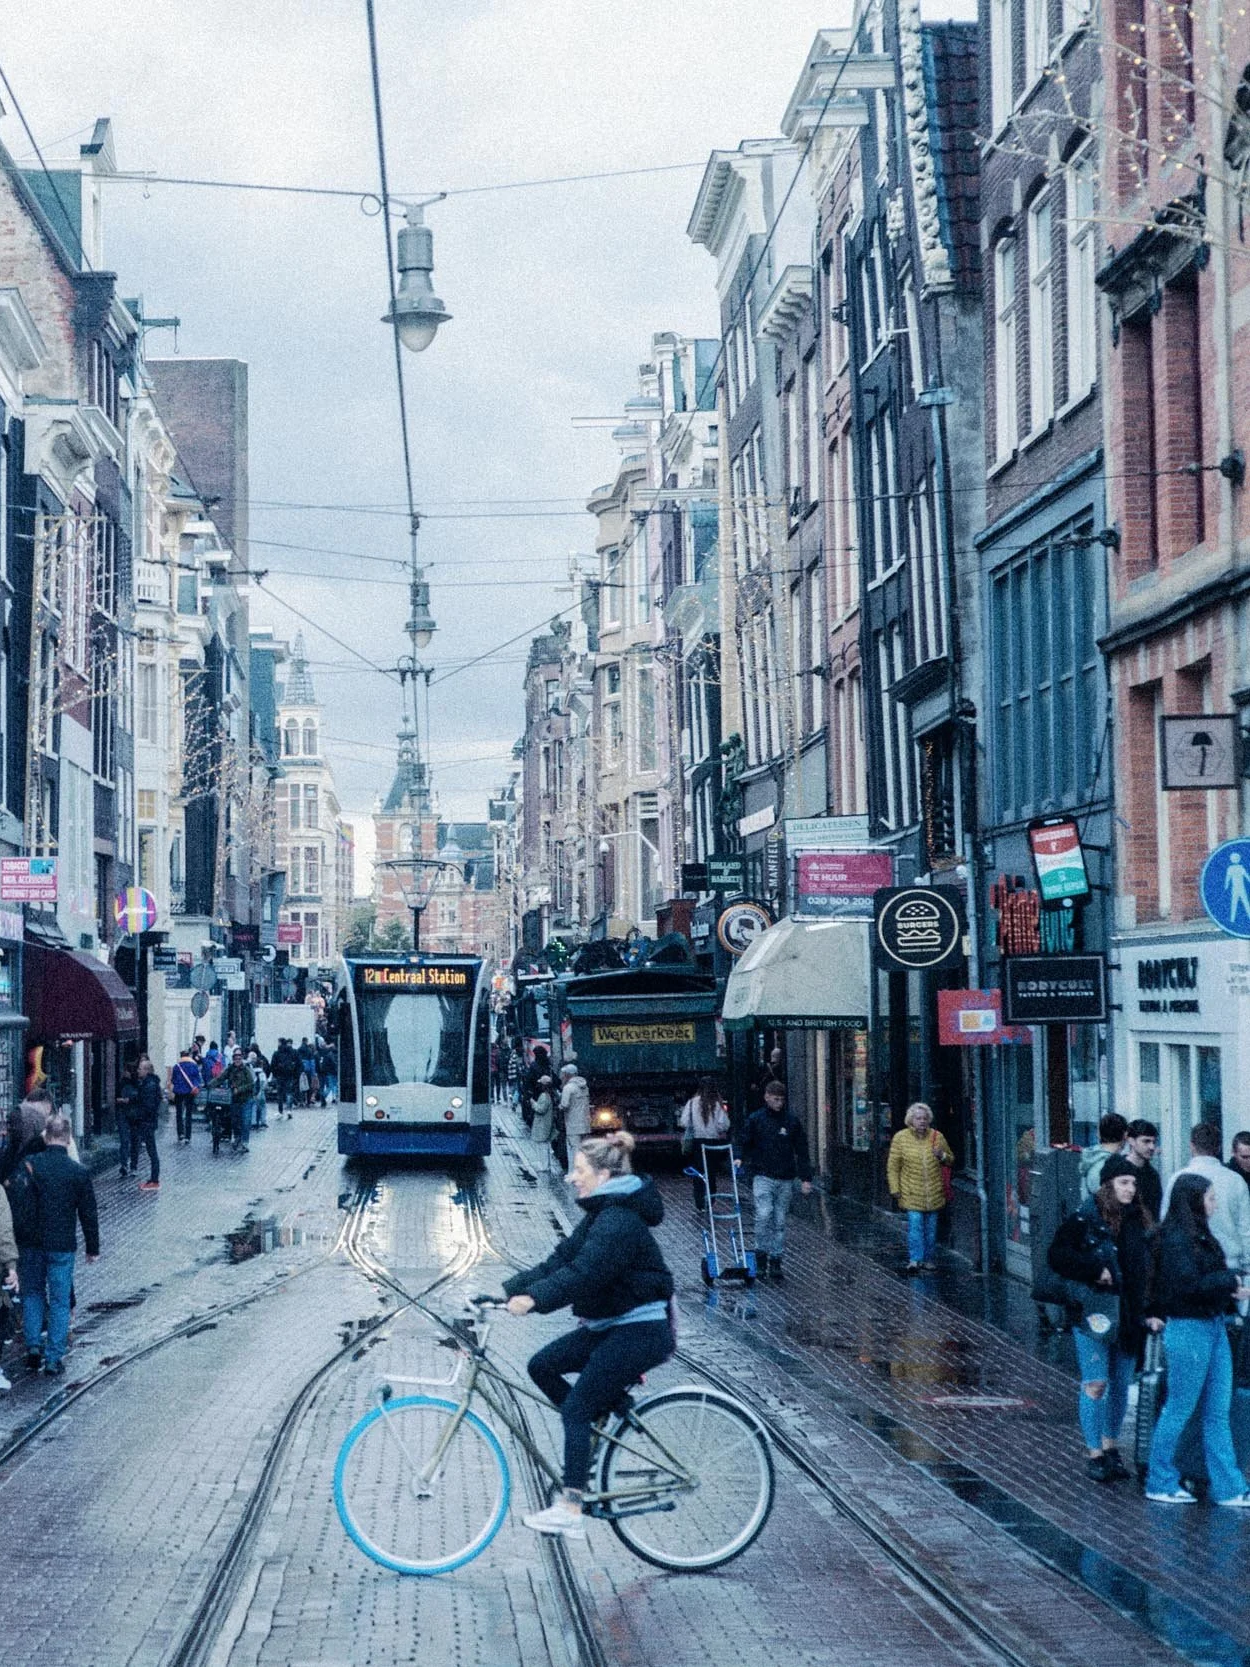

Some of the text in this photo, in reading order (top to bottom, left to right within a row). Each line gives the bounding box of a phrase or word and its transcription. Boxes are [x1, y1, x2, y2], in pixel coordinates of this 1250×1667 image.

[793, 821, 861, 831] DELICATESSEN
[897, 921, 939, 929] BURGERS
[364, 968, 466, 984] 12 Centraal Station
[1017, 981, 1094, 991] BODYCULT
[786, 1019, 803, 1027] AND
[804, 1019, 837, 1027] BRITISH
[838, 1019, 862, 1027] FOOD
[597, 1027, 691, 1041] Werkverkeer
